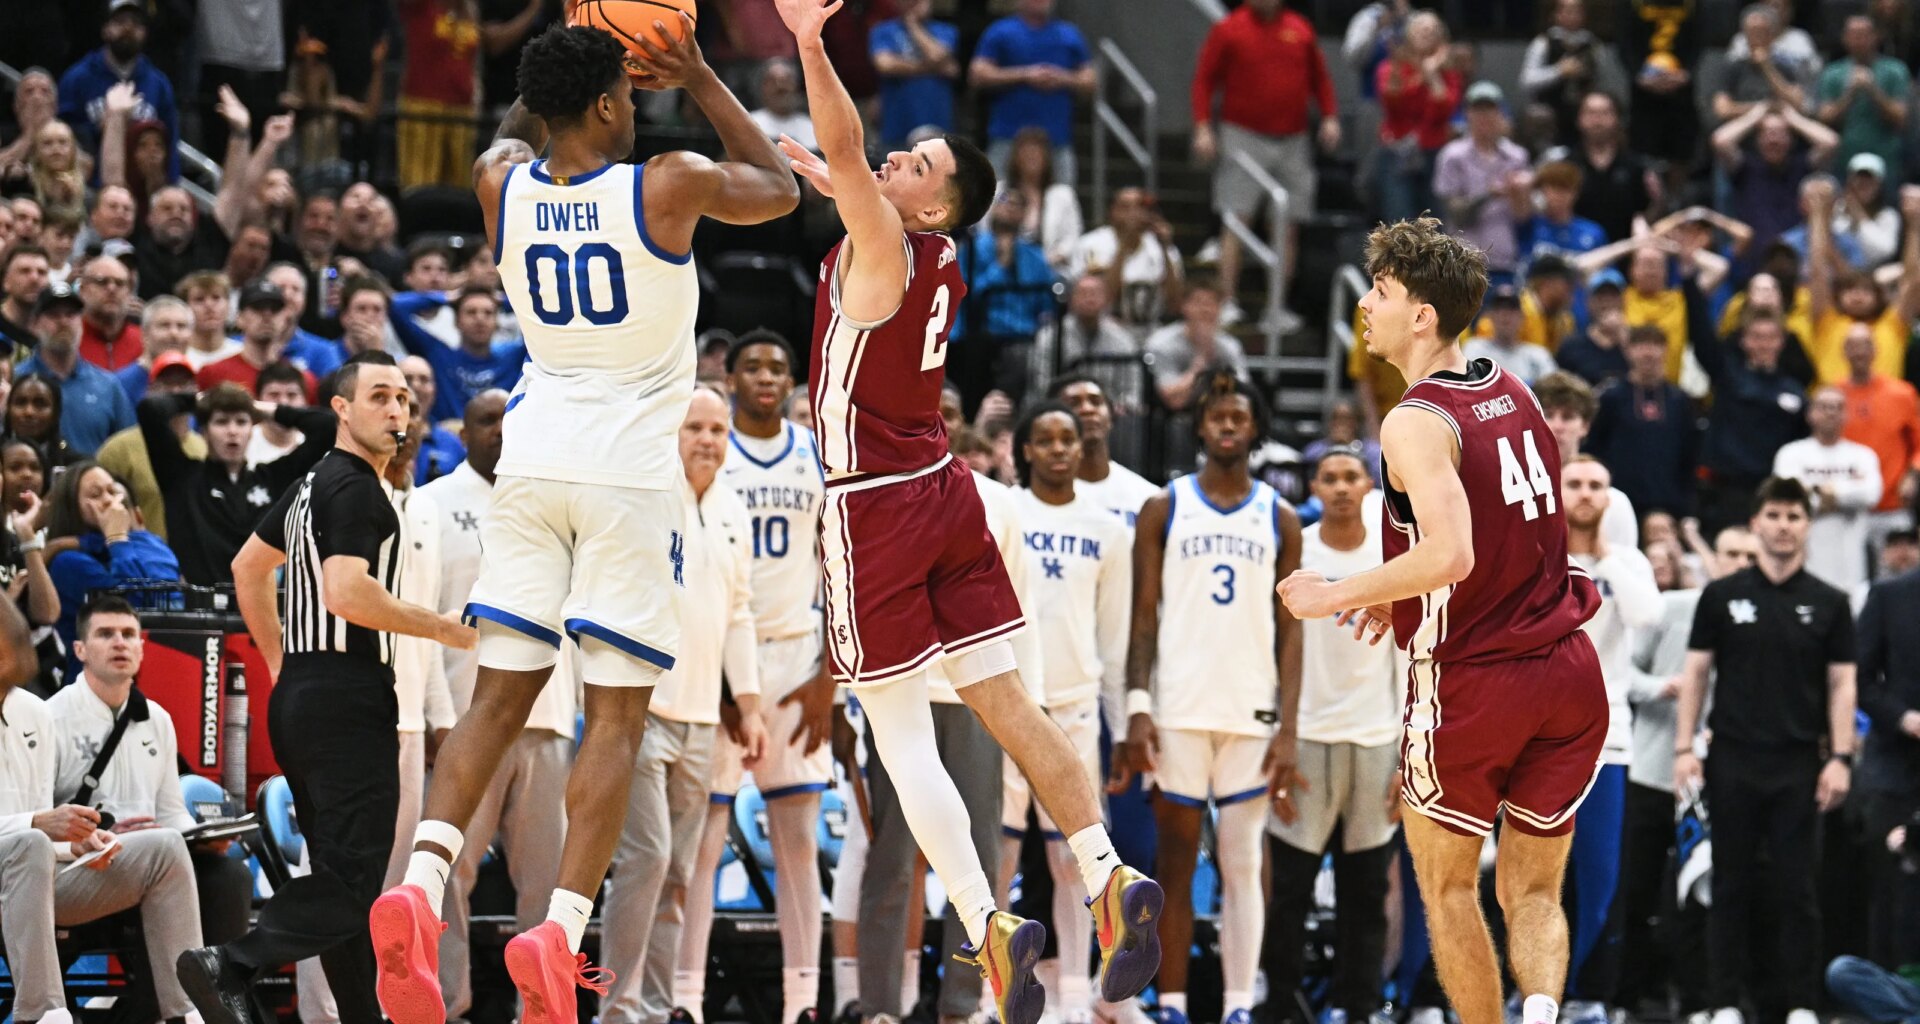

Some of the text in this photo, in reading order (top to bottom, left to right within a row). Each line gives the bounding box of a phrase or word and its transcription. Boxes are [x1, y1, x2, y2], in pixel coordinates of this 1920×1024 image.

[536, 202, 599, 231] OWEH
[524, 242, 629, 325] 00
[920, 283, 949, 372] 2
[1471, 394, 1517, 422] ENSMINGER
[1496, 429, 1556, 522] 44
[736, 486, 814, 513] NTUCKY
[752, 516, 789, 558] 10
[1061, 536, 1076, 553] IT
[1181, 534, 1265, 566] KENTUCKY
[1211, 564, 1235, 605] 3
[203, 637, 219, 766] BODYARMOR
